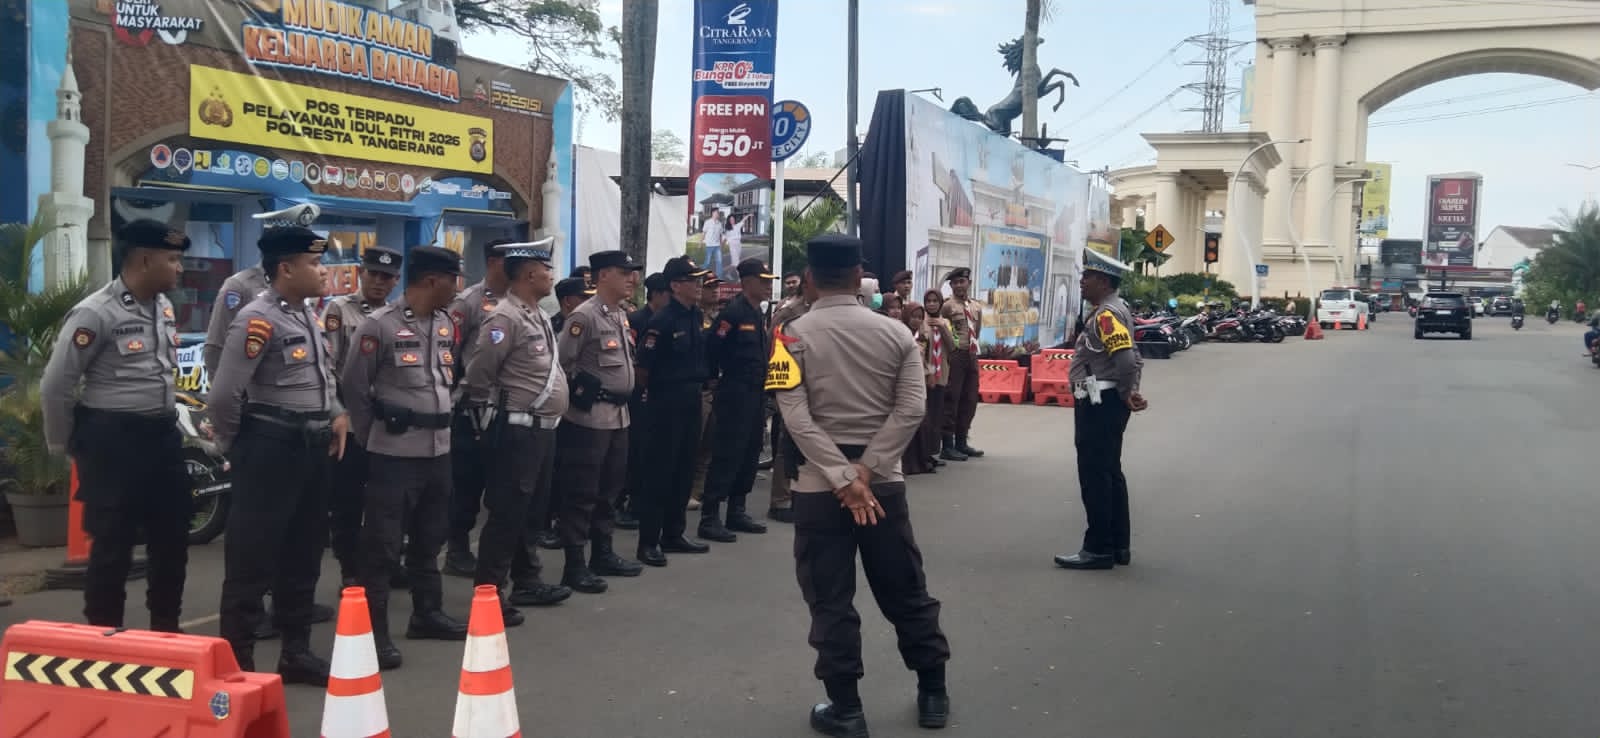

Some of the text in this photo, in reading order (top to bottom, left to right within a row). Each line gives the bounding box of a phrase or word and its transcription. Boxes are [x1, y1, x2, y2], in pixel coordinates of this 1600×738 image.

[116, 2, 158, 16] UNTUK
[116, 14, 203, 30] MASYARAKAT
[284, 0, 432, 57] MUDIK AMAN
[243, 25, 460, 101] KELUARGA BAHAGIA
[714, 63, 734, 71] KPR
[695, 71, 733, 82] Bunga
[305, 99, 416, 127] POS TERPADU
[700, 104, 765, 116] FREE PPN
[243, 102, 345, 130] PELAYANAN
[350, 121, 385, 136] IDUL
[389, 127, 425, 142] FITRI
[429, 132, 461, 146] 2026
[266, 121, 445, 156] POLRESTA TANGERANG
[702, 134, 764, 157] 550 JT
